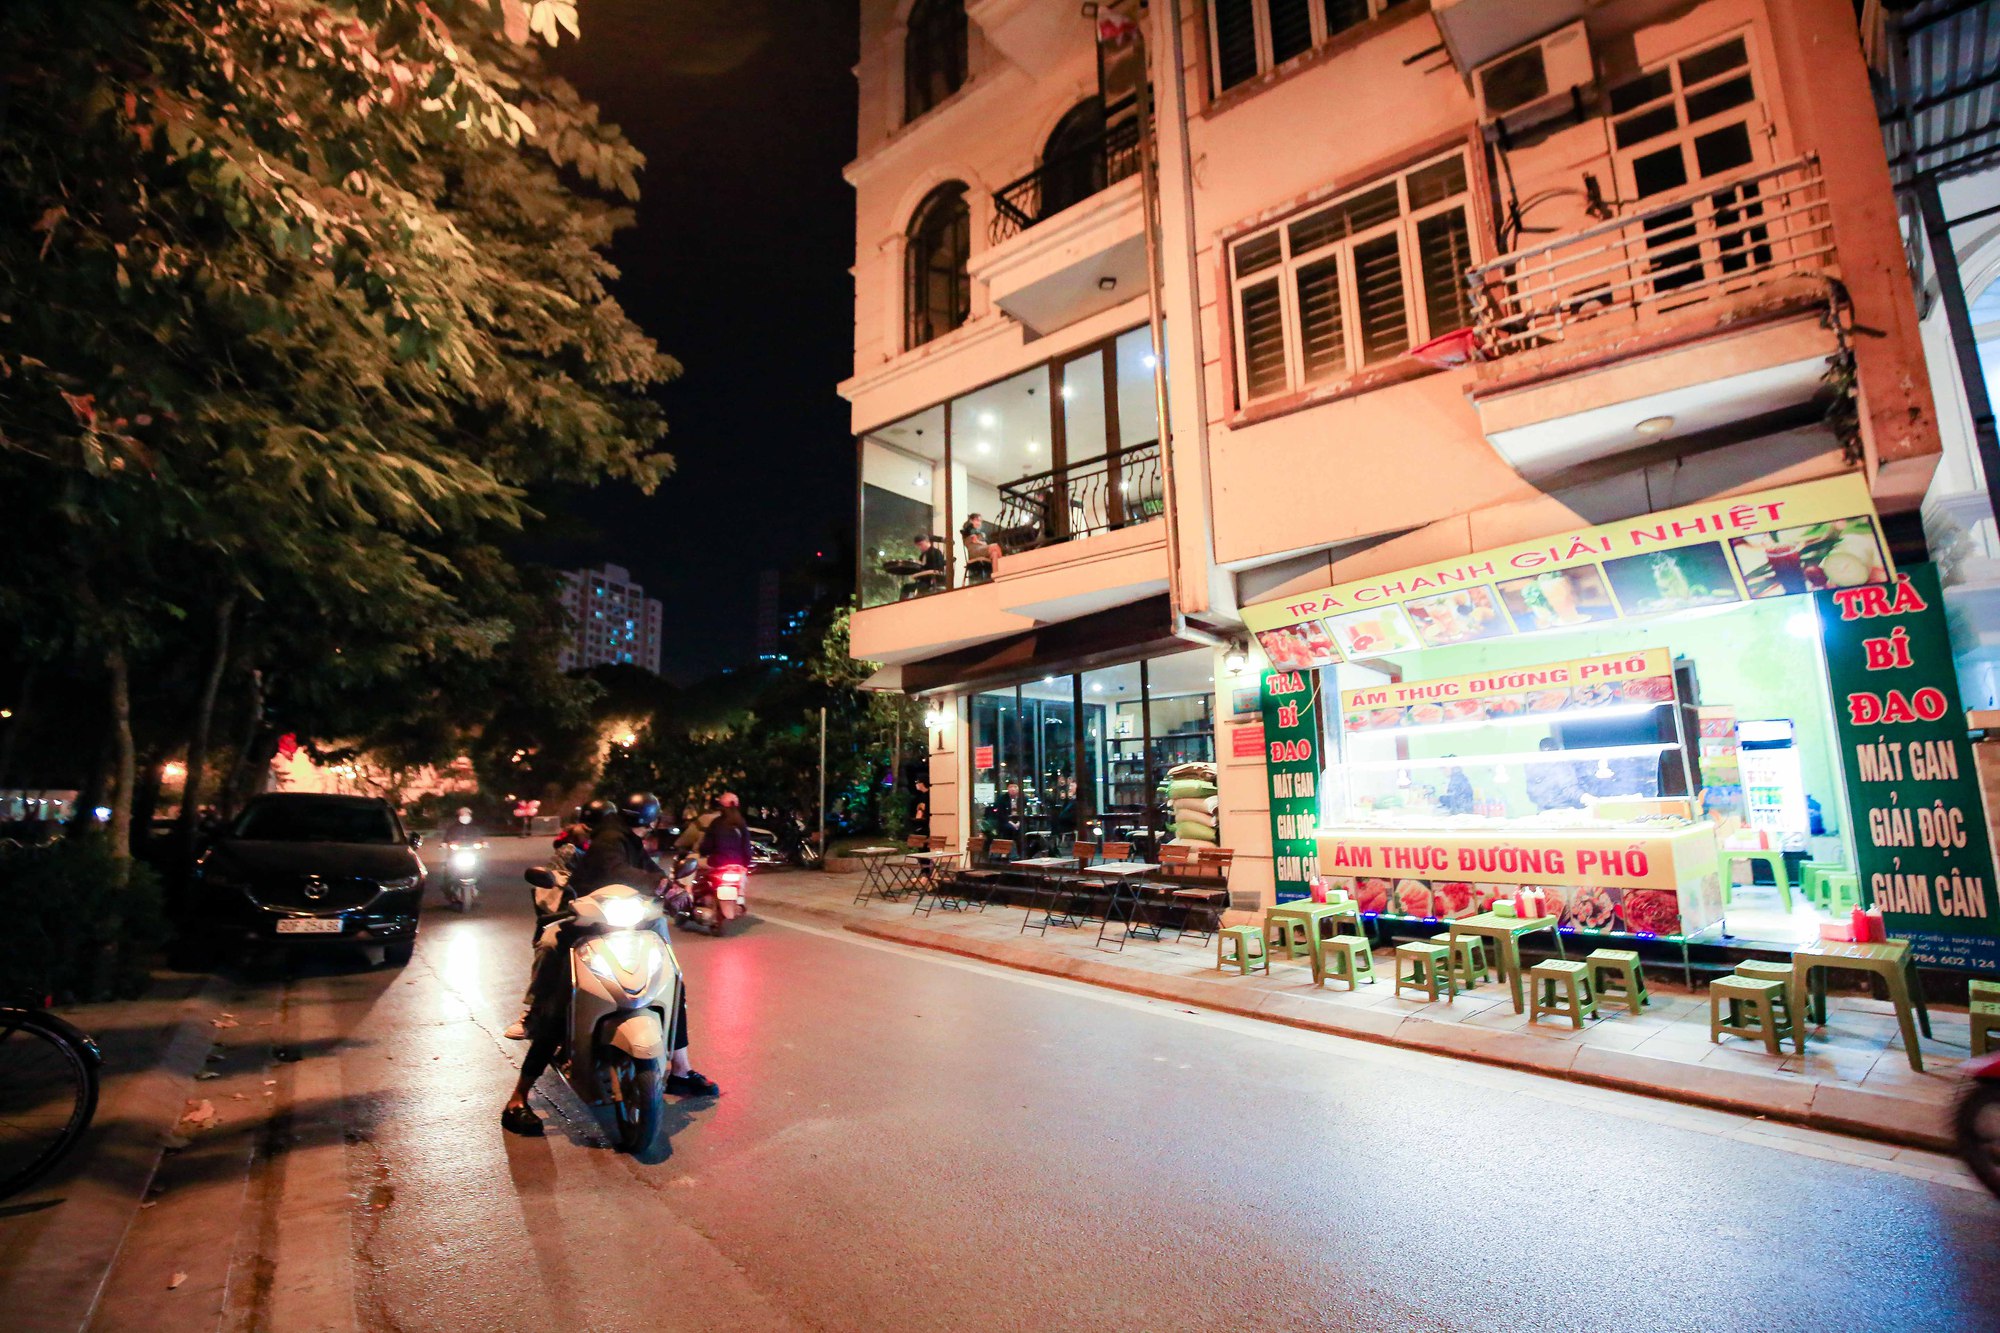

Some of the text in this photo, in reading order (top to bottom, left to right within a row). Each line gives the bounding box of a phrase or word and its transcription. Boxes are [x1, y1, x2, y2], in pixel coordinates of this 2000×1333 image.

[1286, 501, 1785, 618] TRÀ CHANH GIẢI NHIỆT
[1833, 572, 1928, 621] TRÀ
[1580, 652, 1646, 679] PHỐ
[1862, 626, 1914, 671] BÍ
[1278, 700, 1299, 728] BÍ
[1848, 687, 1948, 725] ĐAO
[1270, 739, 1311, 762] ĐAO
[1856, 735, 1959, 782] MÁT GAN
[1273, 768, 1315, 798] MÁT GAN
[1277, 804, 1296, 839] GIẢI
[1869, 791, 1967, 857] GIẢI ĐỘC
[1277, 845, 1301, 882] GIẢM
[1379, 845, 1449, 875] THỰC
[1458, 842, 1565, 874] ĐƯỜNG
[1576, 841, 1649, 877] PHỐ
[1872, 857, 1987, 918] GIẢM CÂN
[1940, 955, 1966, 966] 602
[1970, 958, 1996, 969] 124
